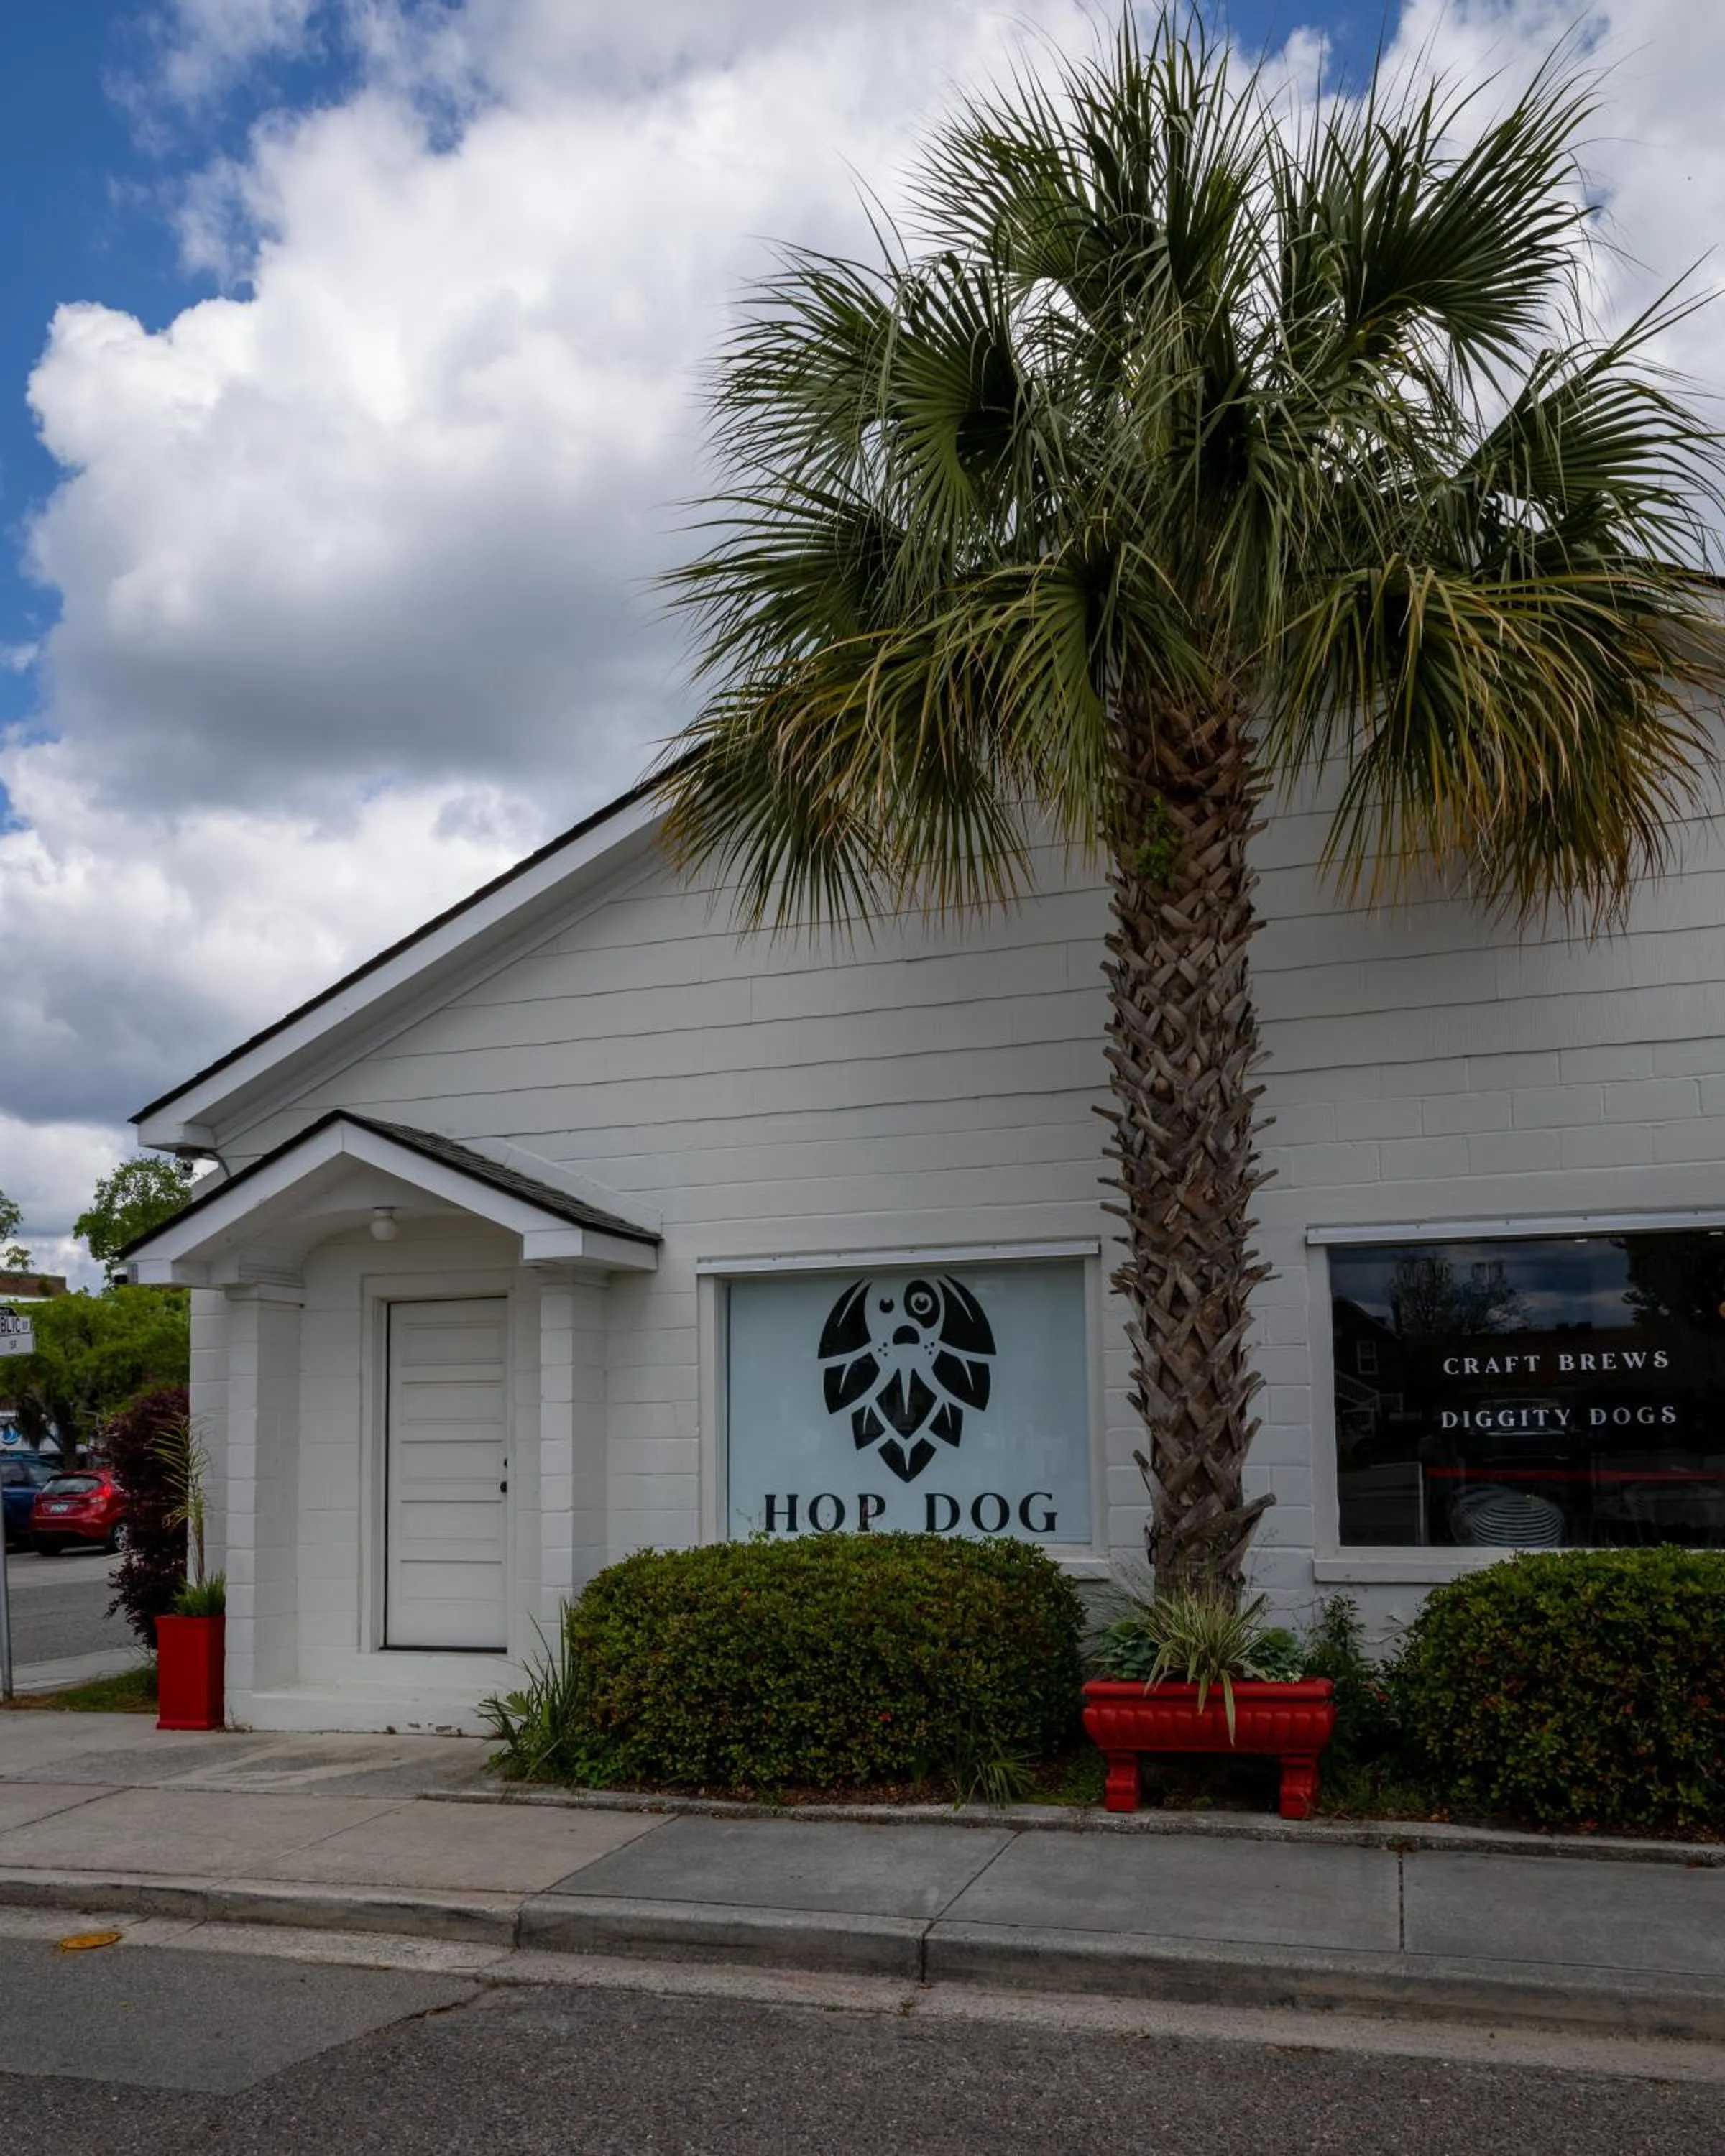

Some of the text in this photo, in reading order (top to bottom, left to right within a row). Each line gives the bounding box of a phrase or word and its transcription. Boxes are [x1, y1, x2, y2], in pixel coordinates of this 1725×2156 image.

[1443, 1350, 1669, 1375] CRAFT BREWS
[1441, 1406, 1677, 1428] DIGGITY DOGS
[764, 1491, 1058, 1534] HOP DOG
